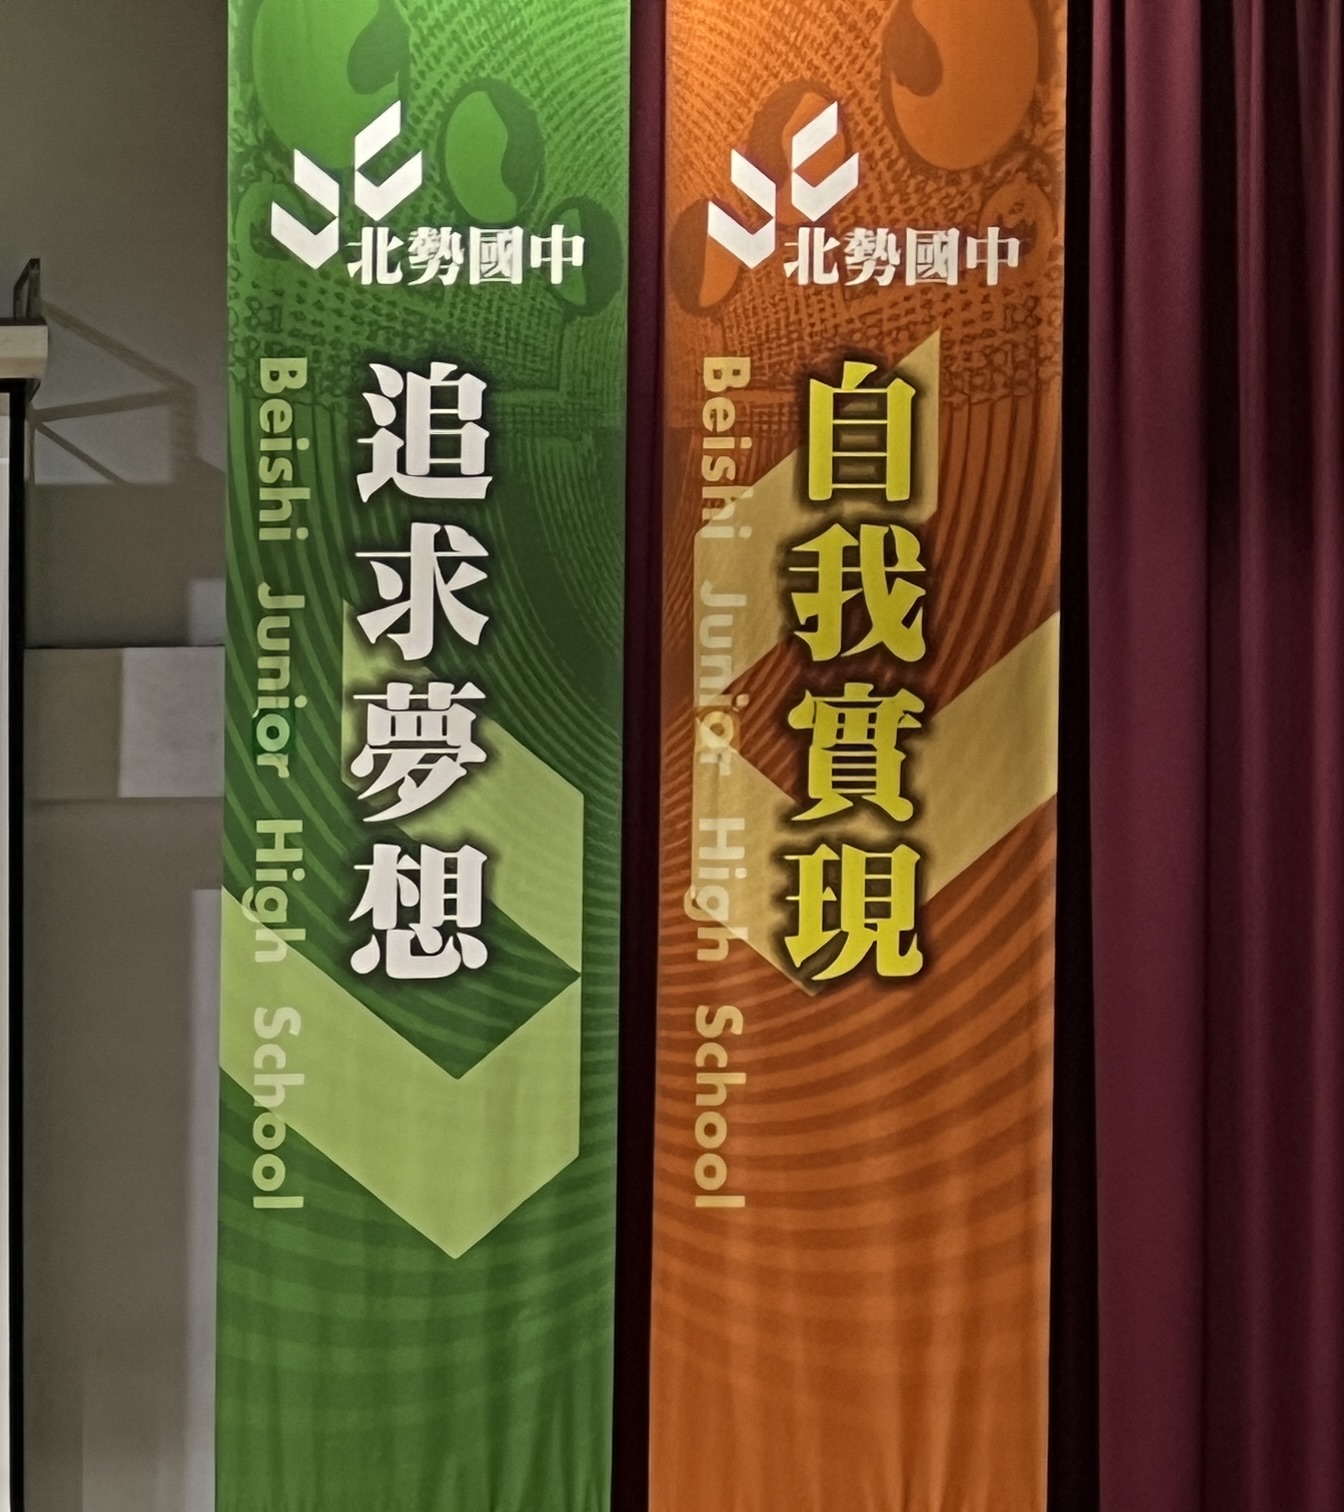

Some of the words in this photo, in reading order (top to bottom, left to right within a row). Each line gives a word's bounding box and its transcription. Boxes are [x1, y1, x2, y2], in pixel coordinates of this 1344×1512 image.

[345, 224, 586, 287] 北勢國中
[783, 224, 1021, 288] 北勢國中
[258, 357, 311, 541] Beishi
[701, 357, 754, 538] Beishi
[256, 582, 308, 779] Junior
[348, 361, 493, 980] 追求夢想
[699, 580, 750, 777] Junior
[784, 362, 926, 982] 自我實現
[241, 820, 306, 963] High
[684, 818, 749, 961] High
[252, 1007, 305, 1209] School
[694, 1006, 747, 1208] School
